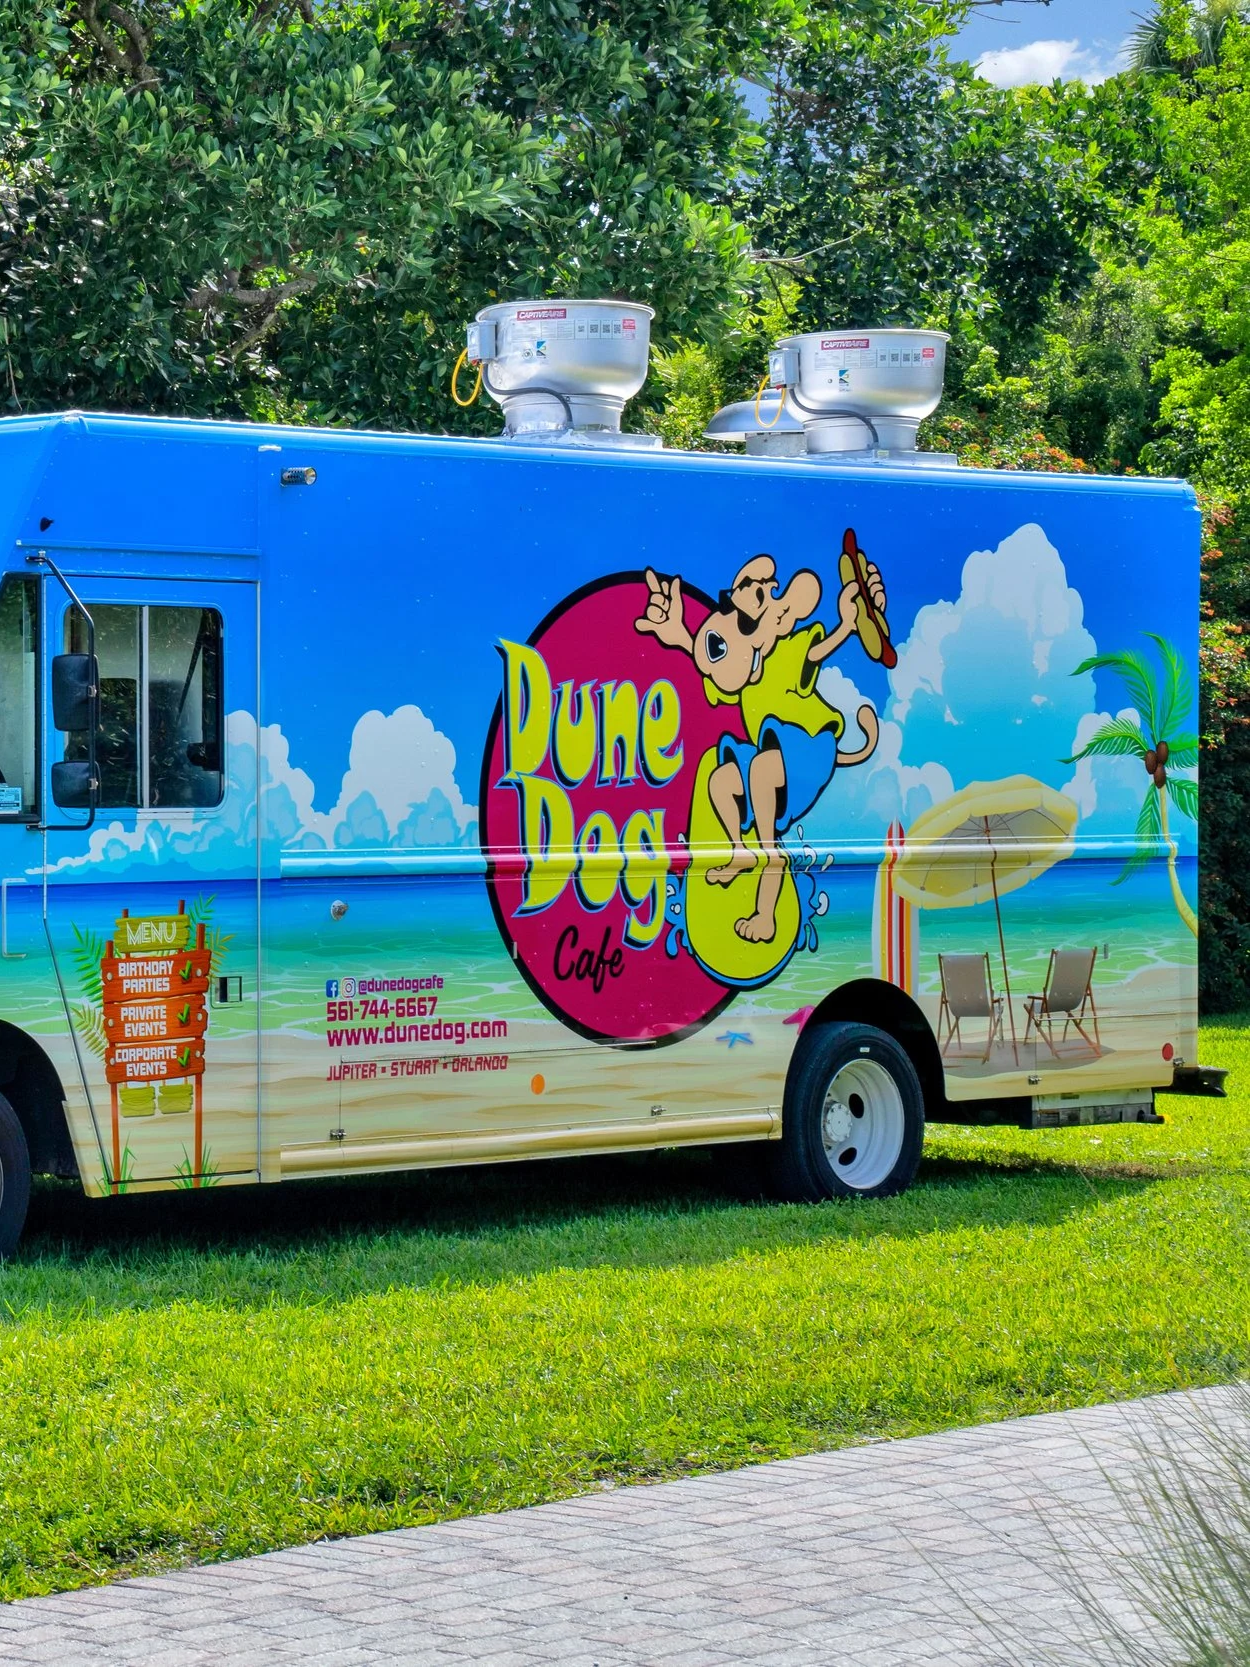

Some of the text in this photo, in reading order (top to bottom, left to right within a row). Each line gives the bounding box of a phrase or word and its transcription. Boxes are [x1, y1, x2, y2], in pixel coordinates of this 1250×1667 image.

[494, 636, 685, 789] Dune
[507, 772, 667, 950] Dog
[126, 921, 177, 945] MENU
[117, 960, 175, 977] BIRTHDAY
[553, 924, 625, 993] Cafe
[123, 977, 171, 994] PARTIES
[358, 975, 444, 995] @dunedogcafe
[120, 1005, 167, 1021] PRIVATE
[326, 996, 438, 1022] 561-744-6667
[124, 1021, 167, 1038] EVENTS
[326, 1018, 508, 1047] www.dunedog.com
[115, 1046, 178, 1063] CORPORATE
[126, 1061, 168, 1077] EVENTS
[326, 1055, 509, 1081] JUPITER STUART ORLANDO
